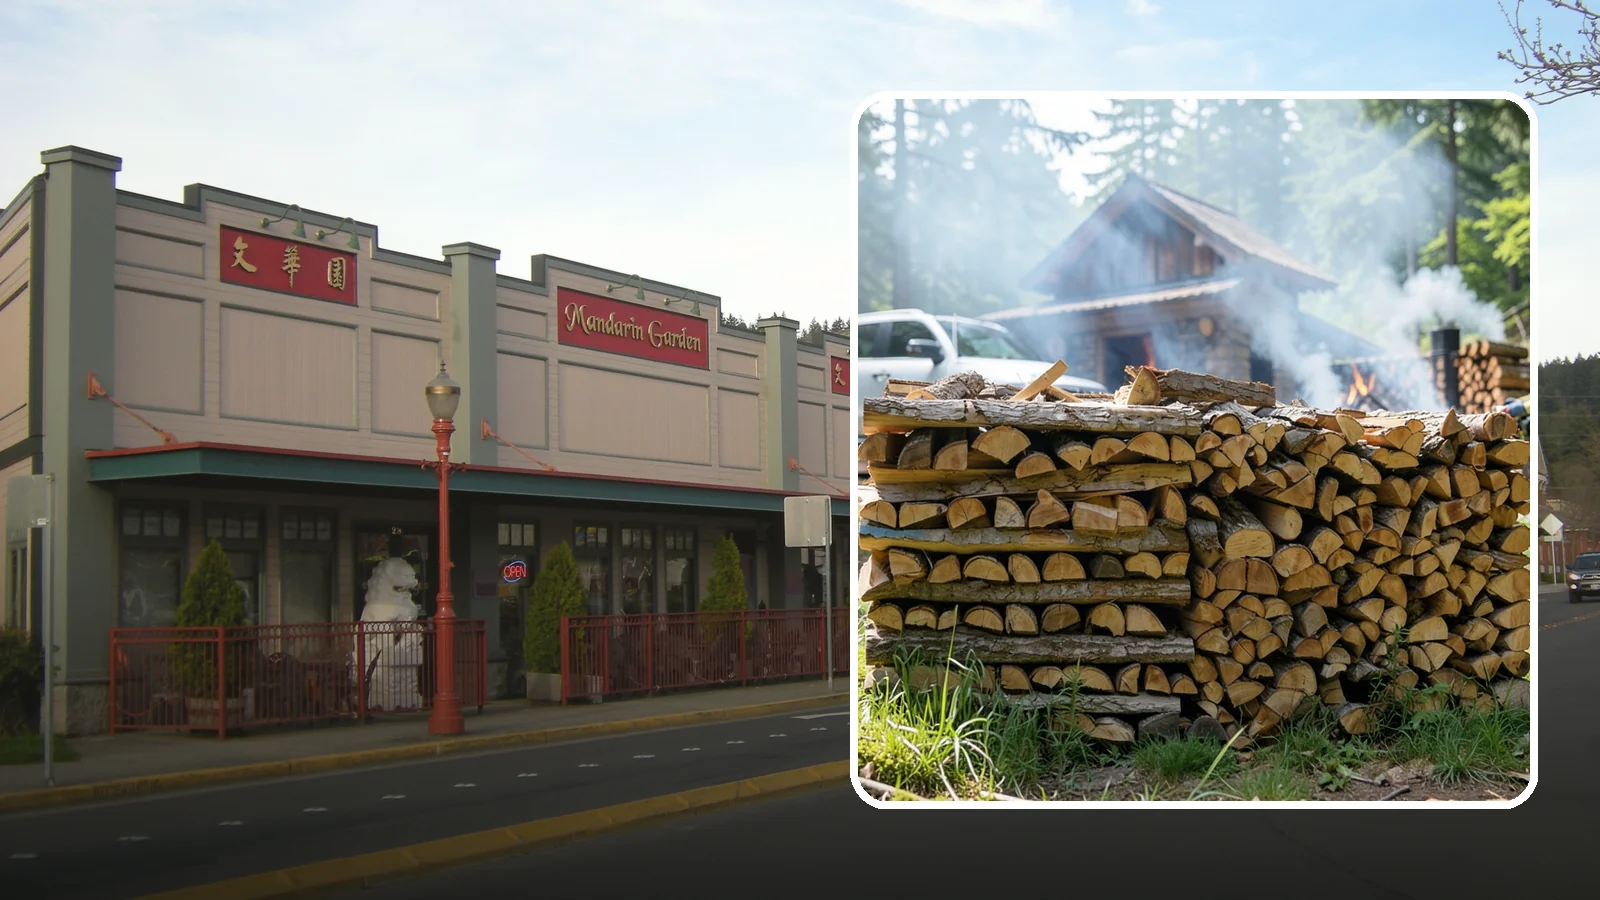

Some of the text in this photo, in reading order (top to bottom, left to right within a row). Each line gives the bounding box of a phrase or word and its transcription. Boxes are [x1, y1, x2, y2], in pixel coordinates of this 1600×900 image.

[231, 235, 346, 291] 文華園
[564, 302, 701, 352] Mandarin Garden
[503, 565, 527, 578] OPEN
